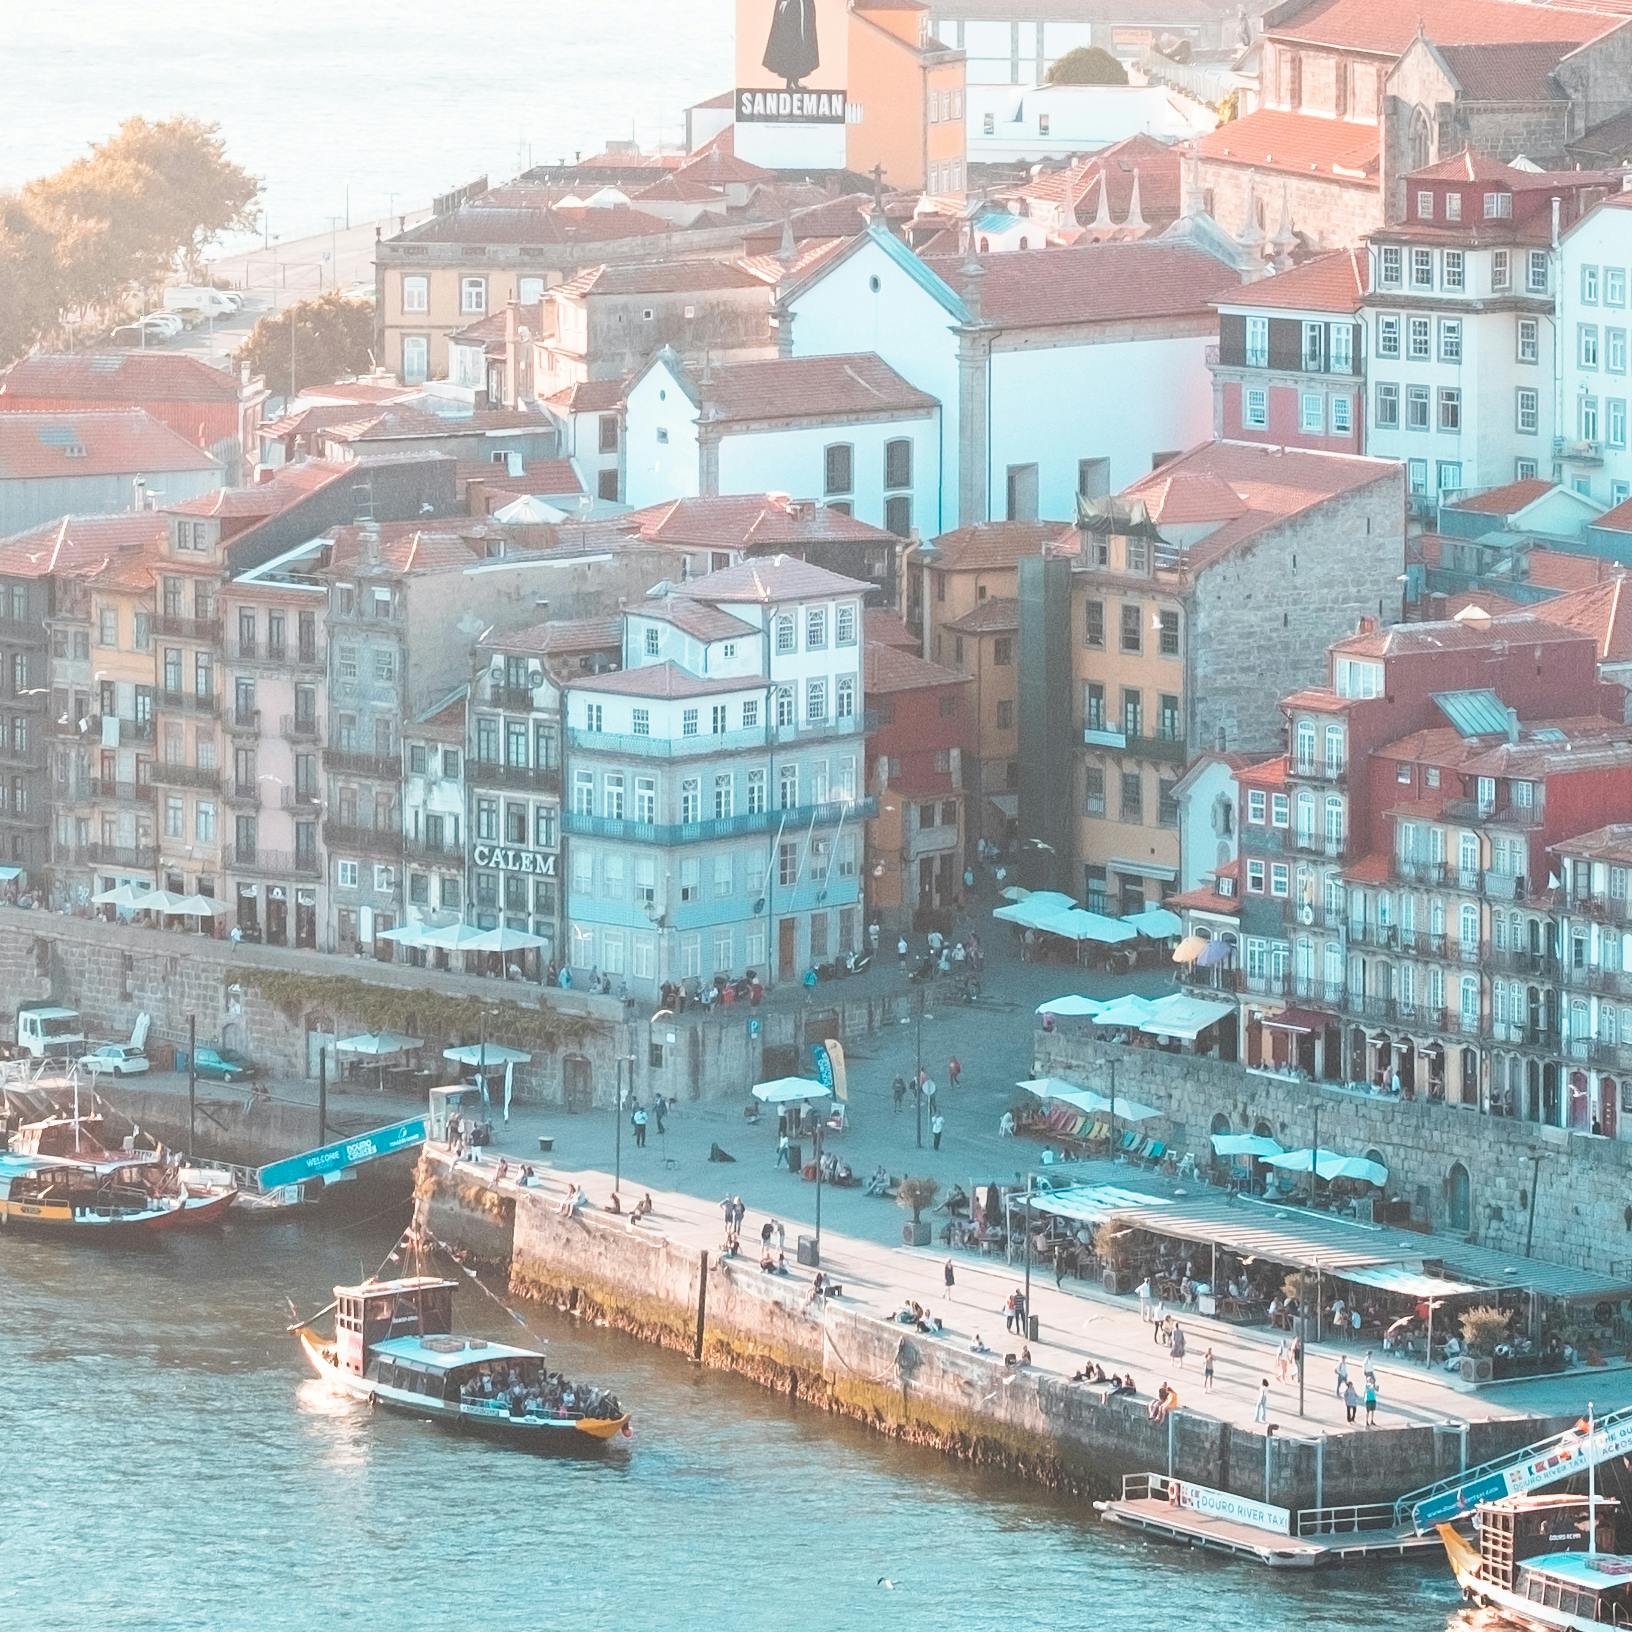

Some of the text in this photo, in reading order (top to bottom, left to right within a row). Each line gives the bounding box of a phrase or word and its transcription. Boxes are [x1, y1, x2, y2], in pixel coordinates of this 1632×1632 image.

[741, 92, 843, 117] SANDEMAN
[306, 1151, 340, 1168] WELCOME
[1201, 1495, 1288, 1528] DOURO RIVER TAXI
